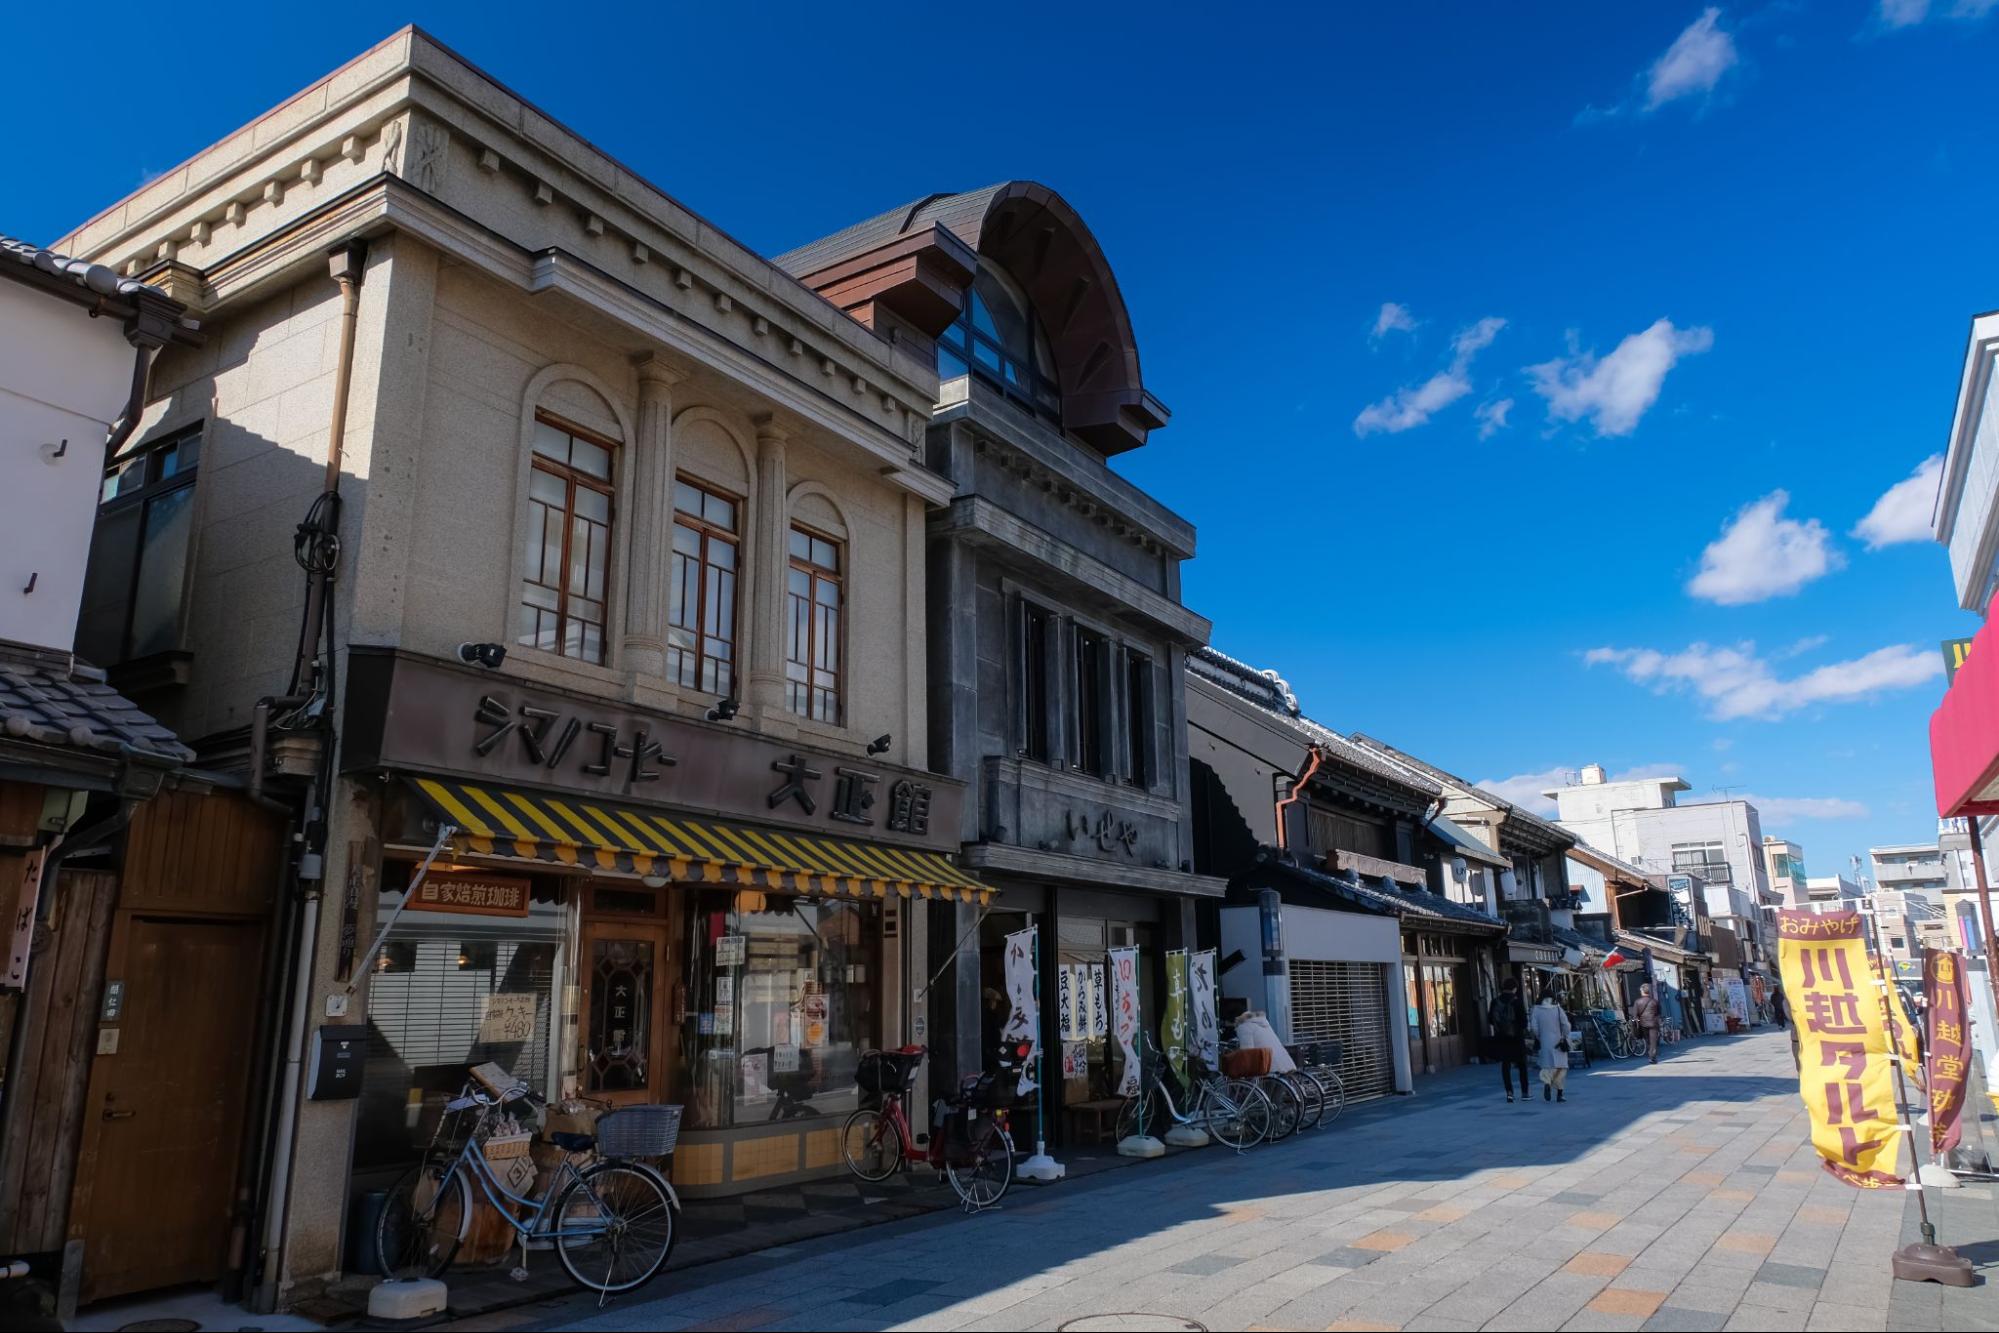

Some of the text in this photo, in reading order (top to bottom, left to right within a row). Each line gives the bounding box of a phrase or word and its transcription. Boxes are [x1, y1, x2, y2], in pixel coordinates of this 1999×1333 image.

[768, 755, 931, 835] 大正館
[1064, 808, 1137, 858] いせや
[11, 859, 37, 980] たばこ
[421, 881, 520, 907] 自家焙煎珈琲
[1780, 916, 1859, 935] おみやげ
[1060, 970, 1071, 1033] 豆大福
[1094, 968, 1104, 1031] 草もち
[1800, 948, 1882, 1166] 川越タルト
